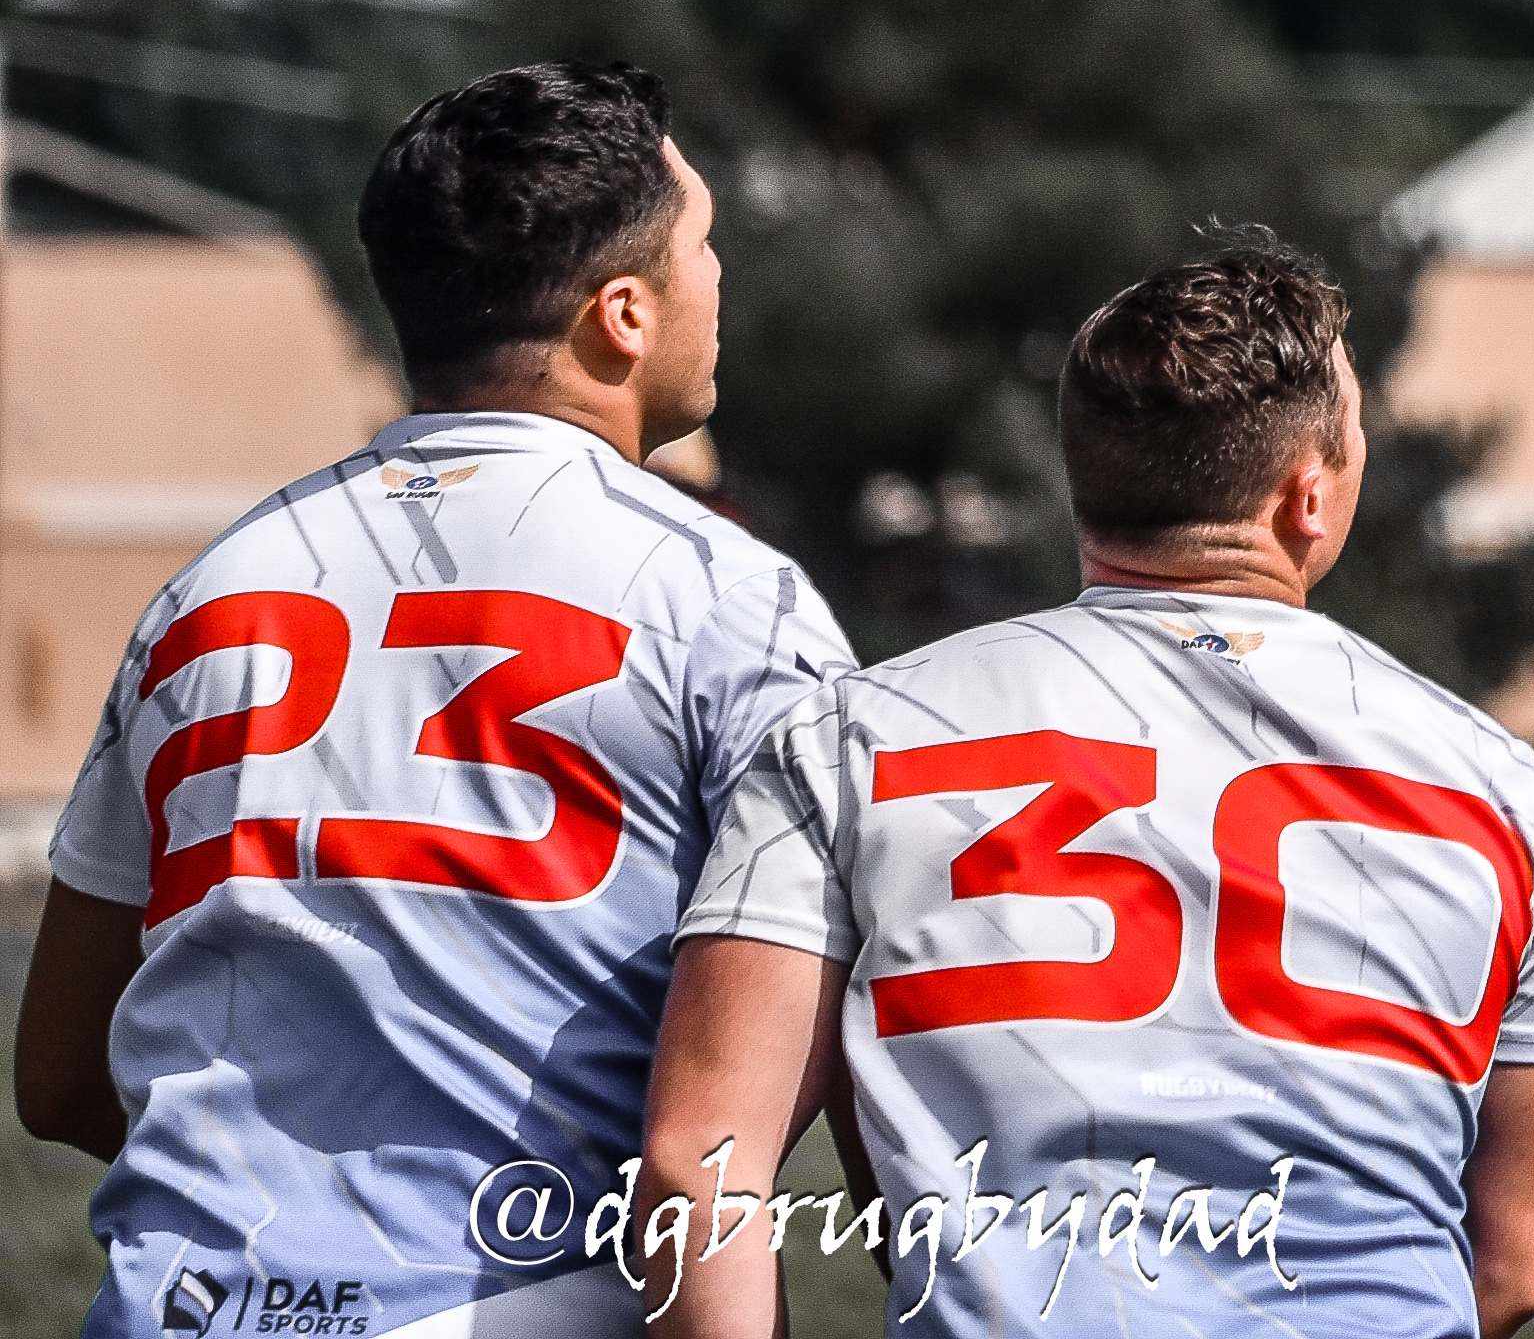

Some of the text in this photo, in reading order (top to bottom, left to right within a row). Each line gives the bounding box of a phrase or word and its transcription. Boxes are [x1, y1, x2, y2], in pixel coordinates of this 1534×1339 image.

[140, 589, 634, 930] 23
[262, 1278, 363, 1314] DAF
[256, 1313, 370, 1335] SPORTS
